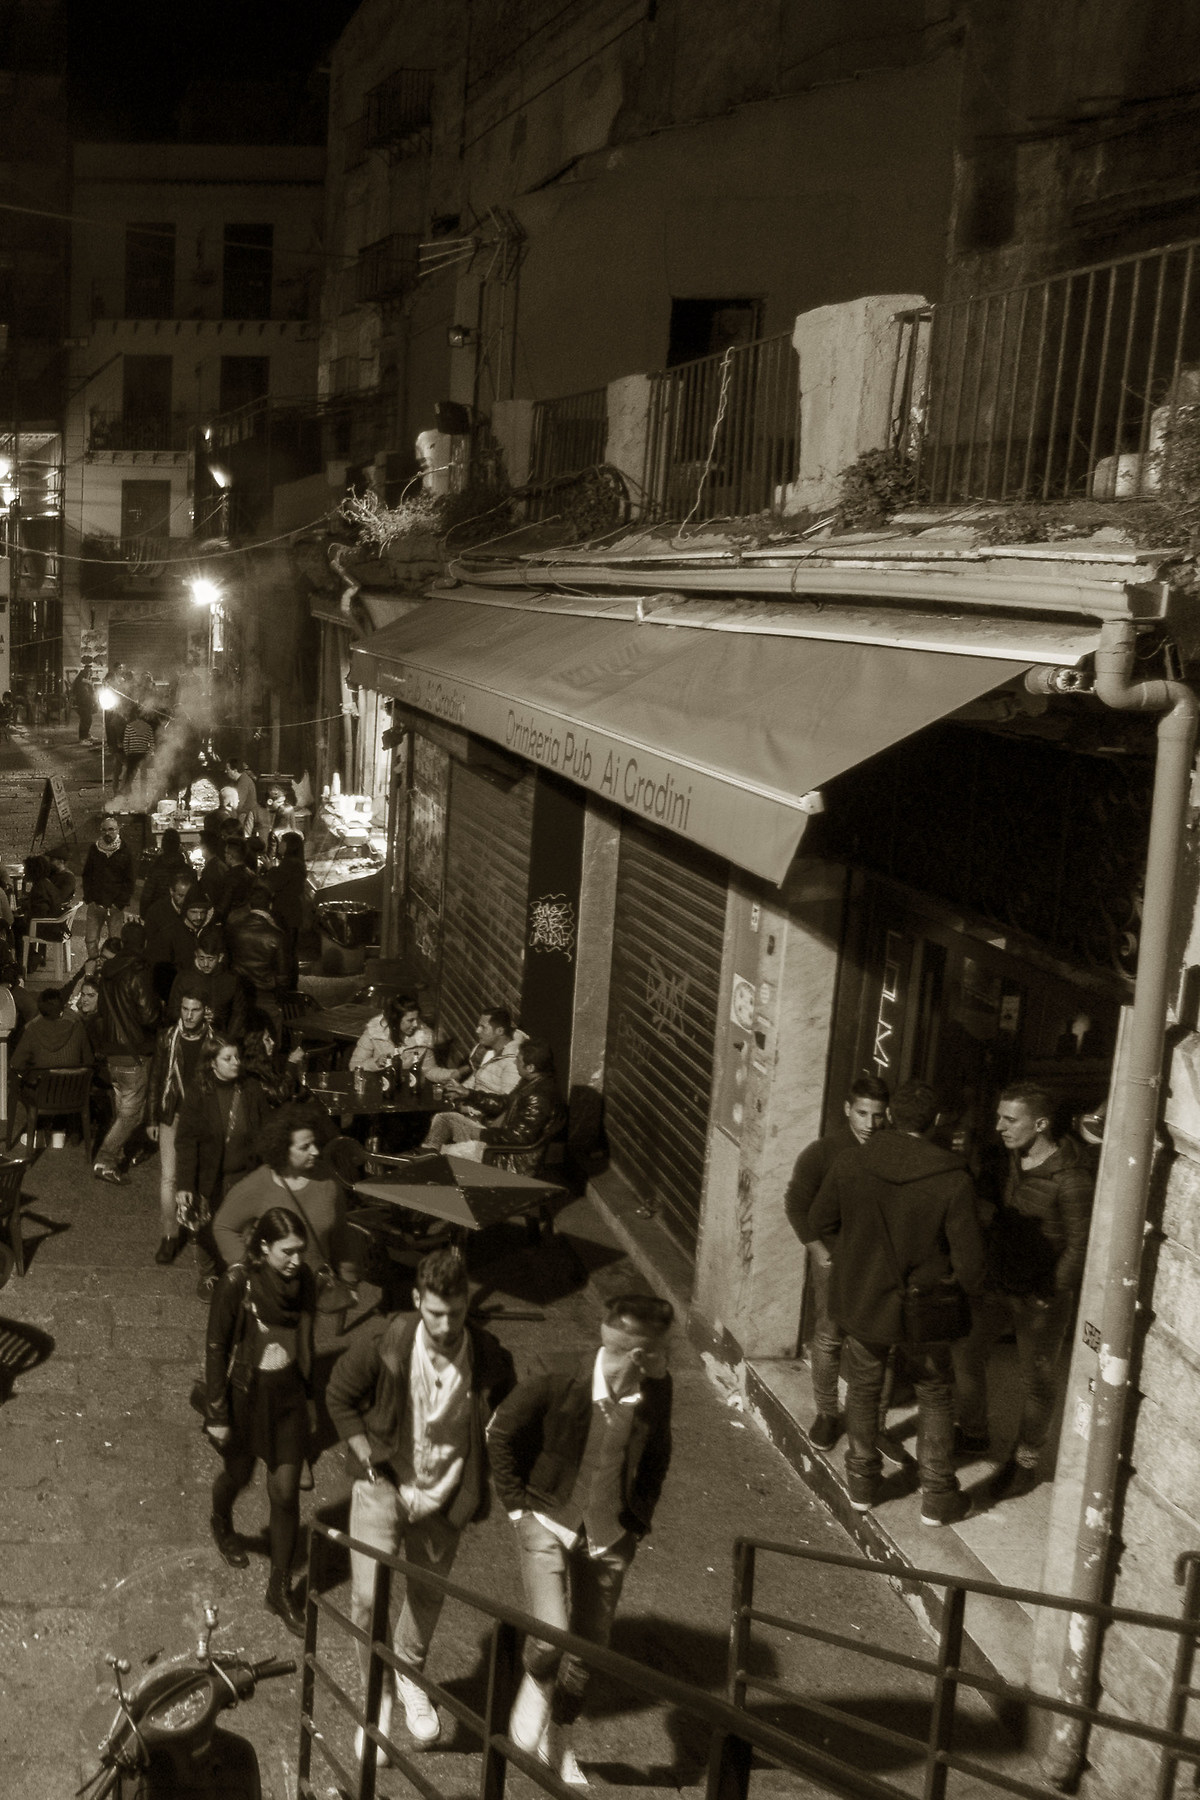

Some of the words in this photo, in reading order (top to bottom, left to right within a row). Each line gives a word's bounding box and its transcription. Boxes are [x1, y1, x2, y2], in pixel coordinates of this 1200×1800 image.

[506, 710, 560, 764] Drinkeria
[562, 732, 592, 781] Pub
[600, 750, 620, 795] Ai
[624, 758, 692, 830] Gradini
